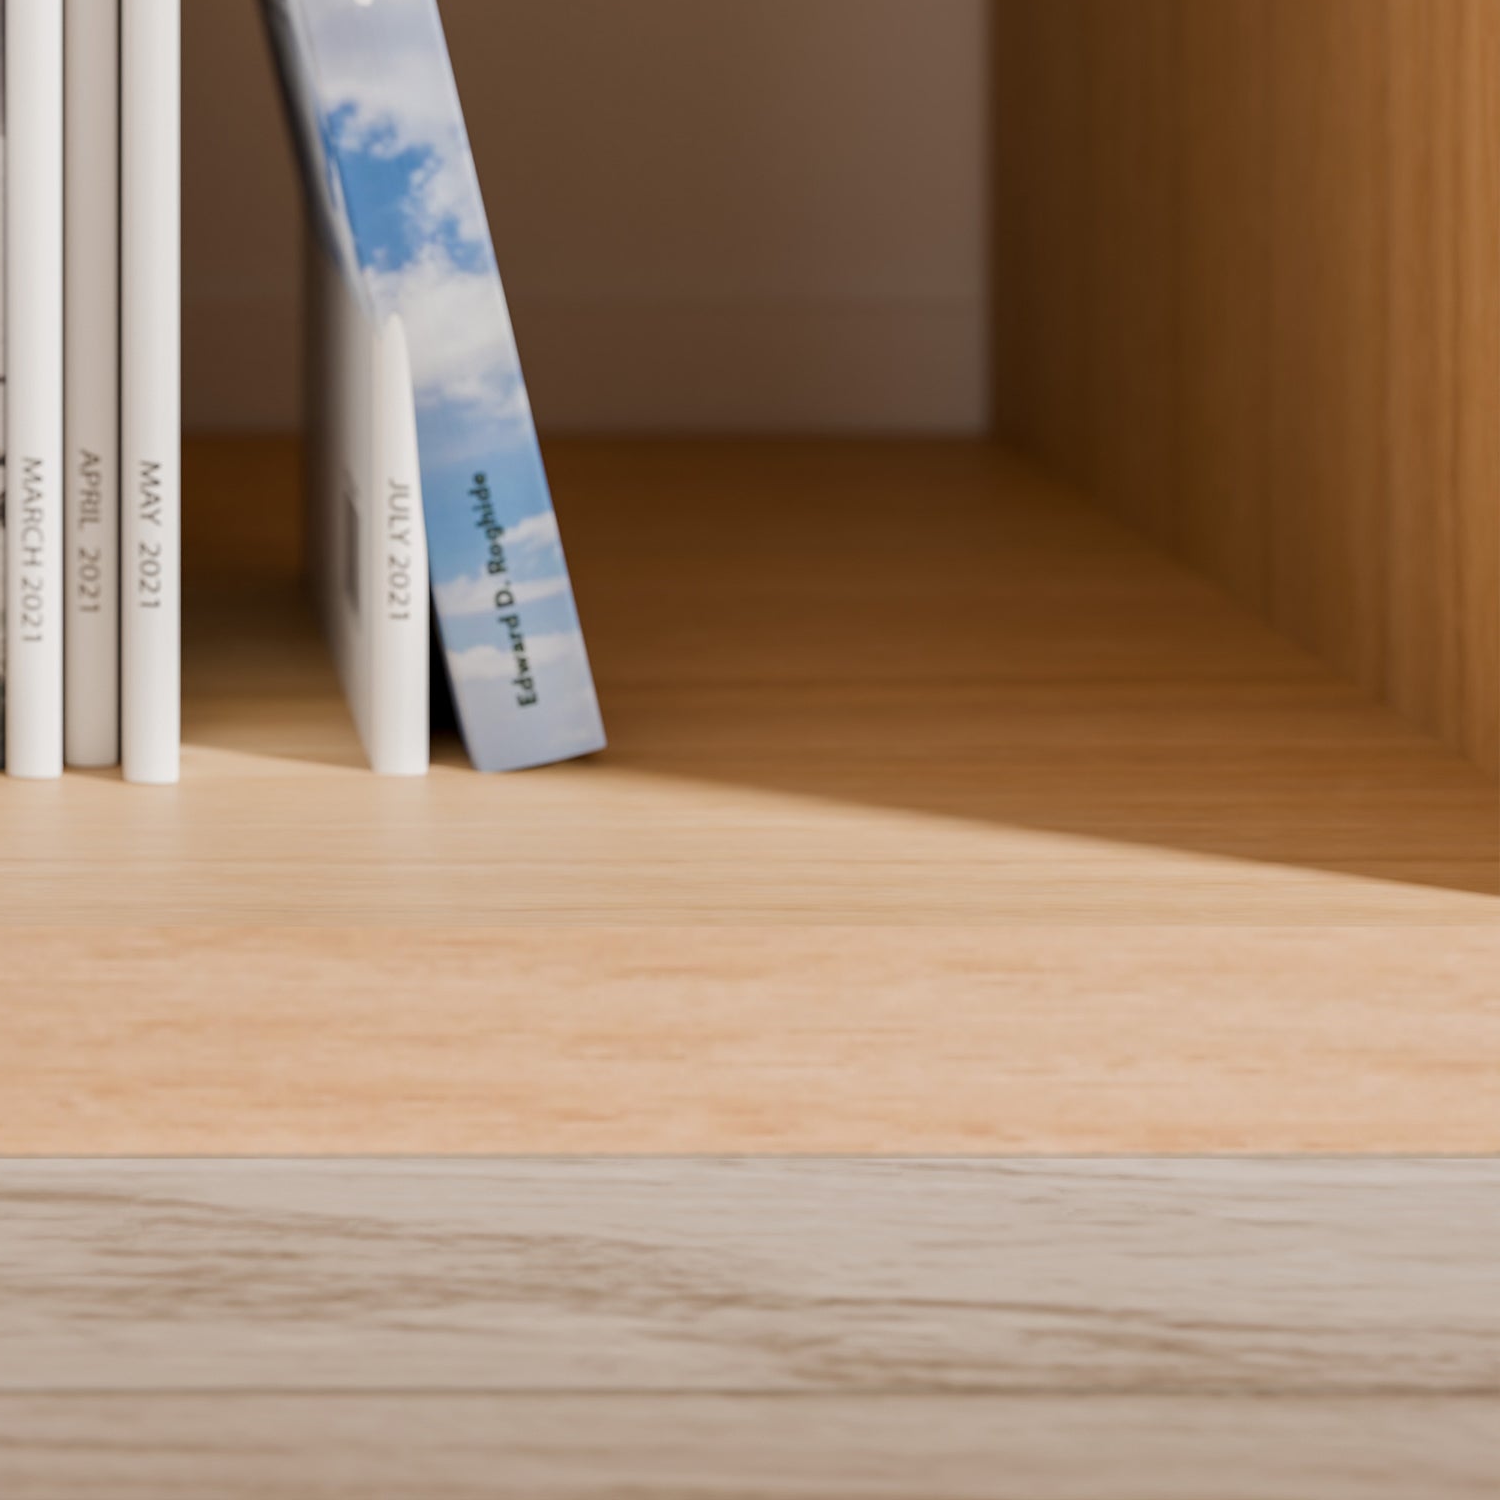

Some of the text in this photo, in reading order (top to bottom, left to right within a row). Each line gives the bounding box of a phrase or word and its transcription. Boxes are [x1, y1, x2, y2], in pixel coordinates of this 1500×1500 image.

[22, 456, 44, 643] MARCH 2021
[79, 449, 101, 614] APRIL 2021
[139, 460, 161, 609] MAY 2021
[387, 478, 410, 622] JULY 2021
[495, 582, 514, 608] D.
[499, 614, 537, 707] Edward
